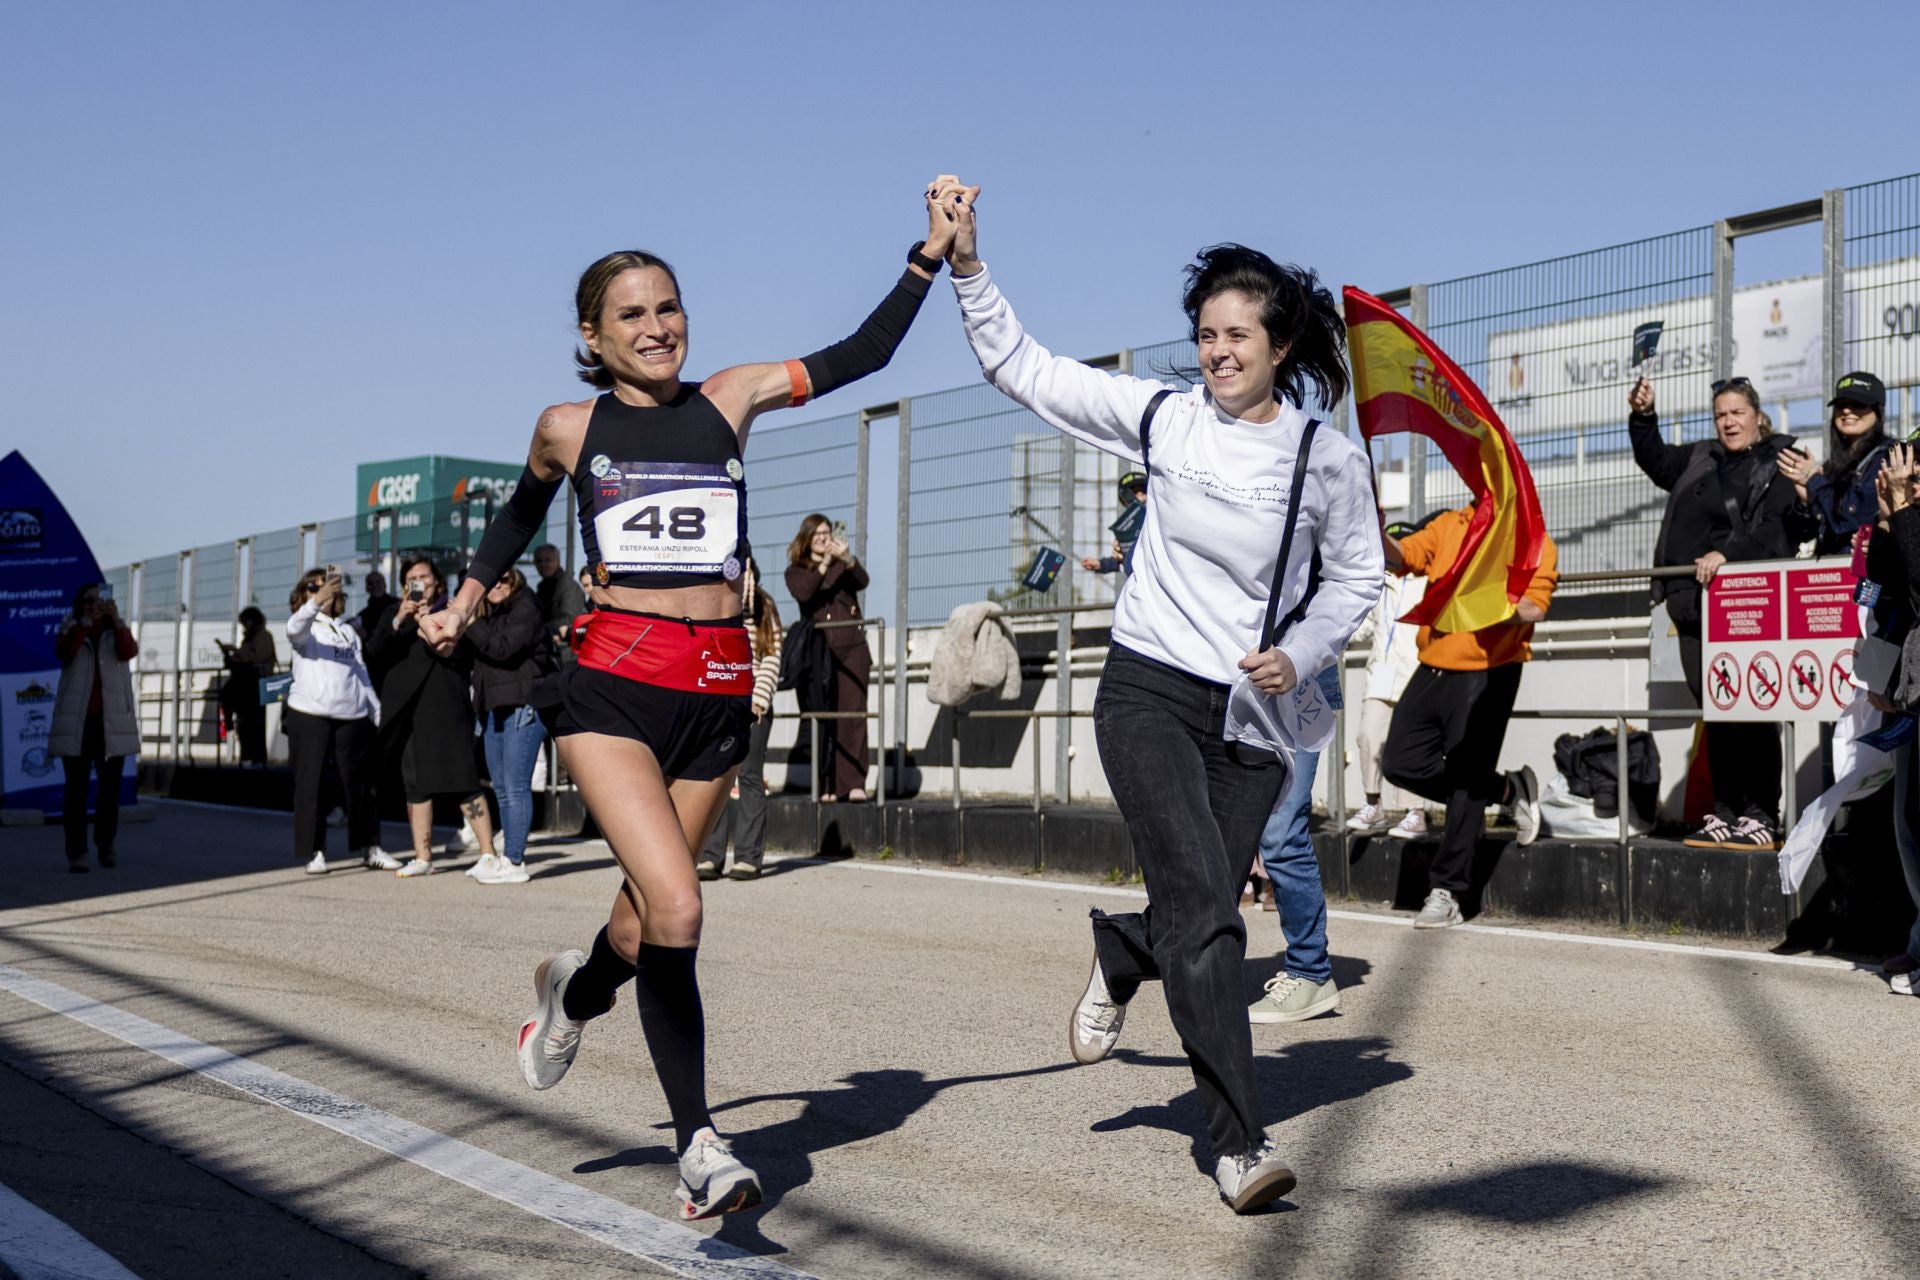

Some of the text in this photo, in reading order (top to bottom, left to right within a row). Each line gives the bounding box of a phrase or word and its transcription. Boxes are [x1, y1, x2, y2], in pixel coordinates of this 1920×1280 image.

[378, 472, 421, 506] caser
[601, 488, 619, 497] 777
[621, 505, 706, 540] 48
[619, 544, 660, 552] ESTEFANIA
[682, 545, 709, 553] RIPOLL
[1721, 576, 1768, 589] ADVERTENCIA
[1807, 572, 1842, 584] WARNING
[1800, 592, 1850, 603] RESTRICTED AREA
[9, 608, 17, 619] 7
[1805, 606, 1844, 617] ACCESS ONLY
[1807, 615, 1842, 624] AUTHORIZED
[1808, 623, 1842, 632] PERSONNEL
[706, 671, 738, 681] SPORT
